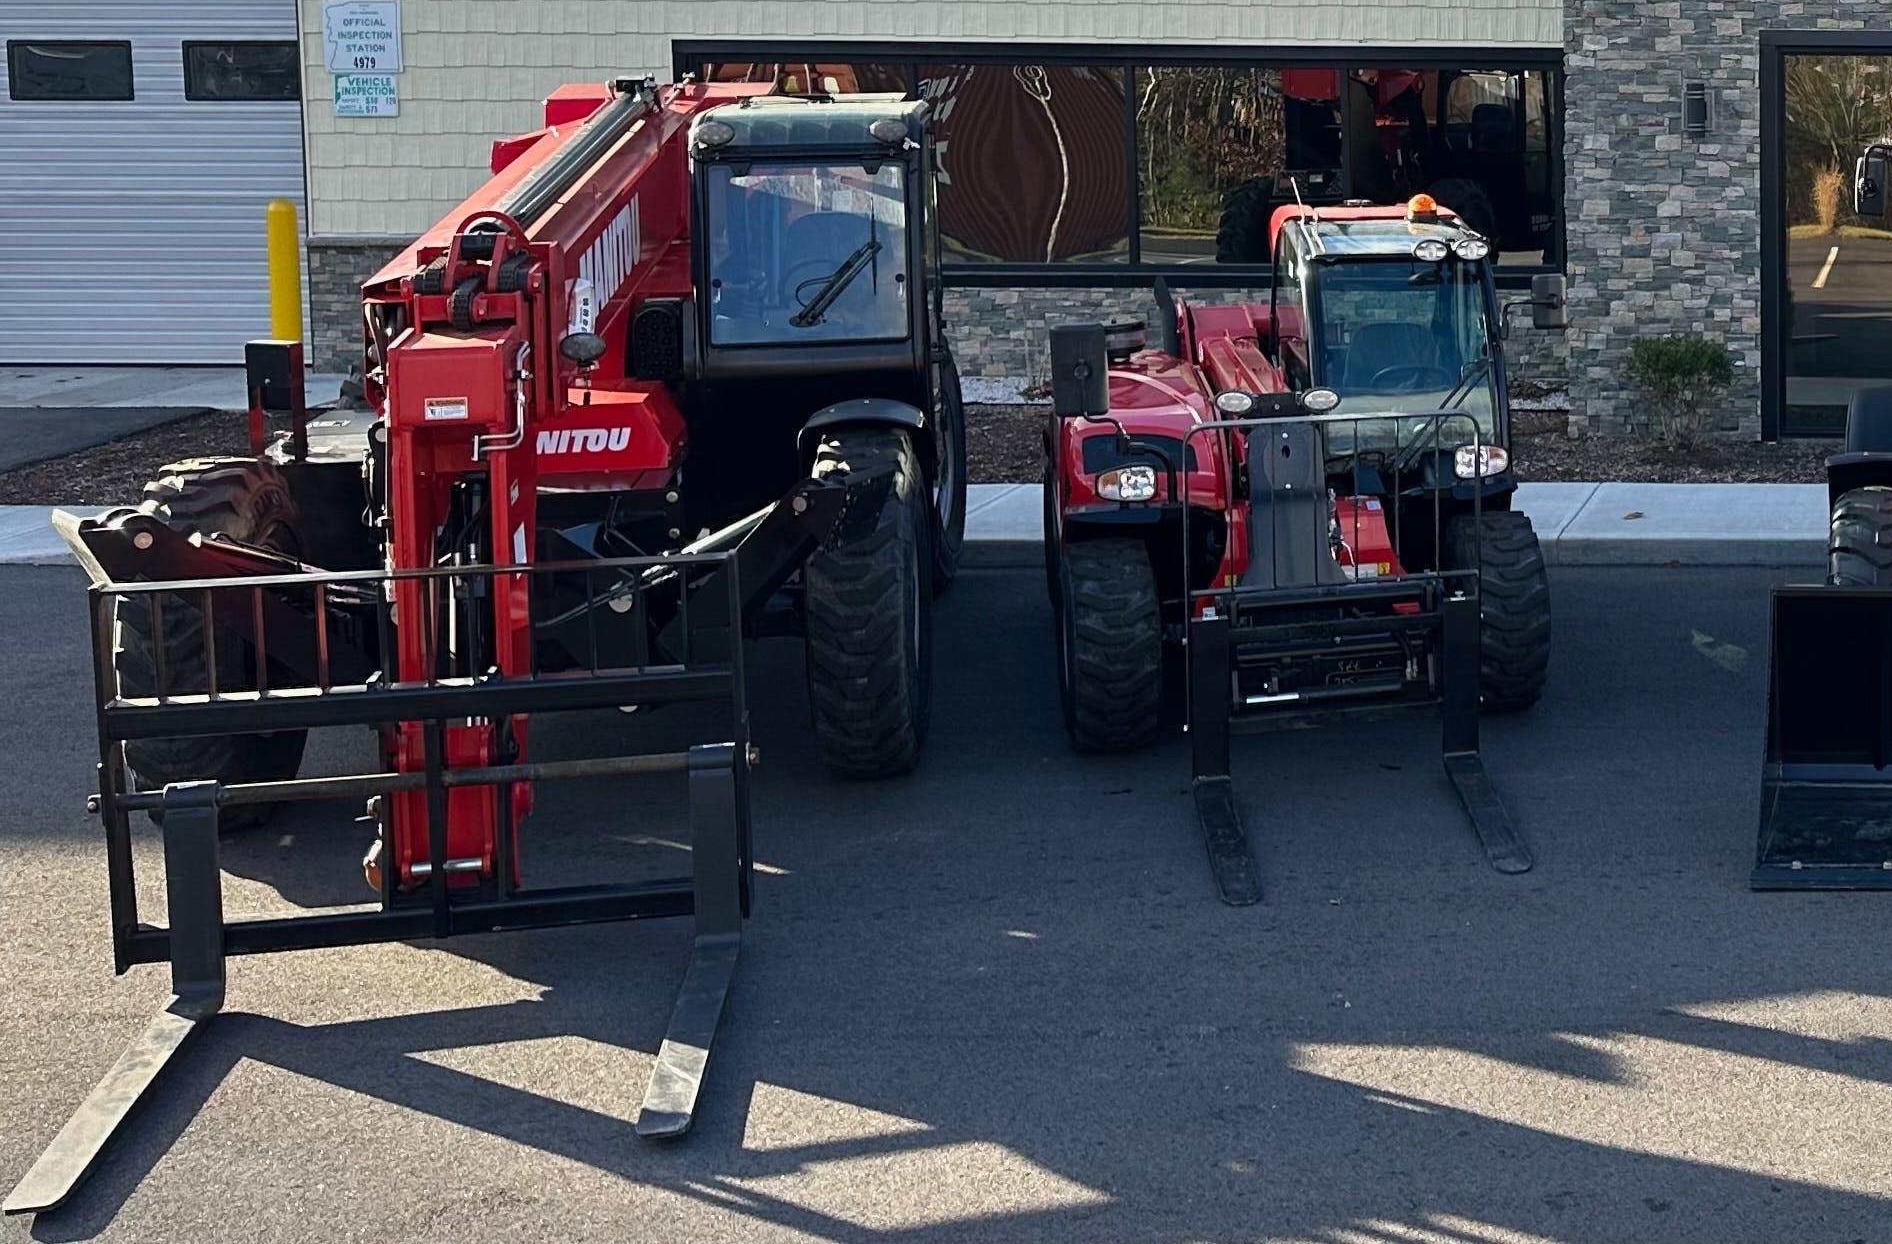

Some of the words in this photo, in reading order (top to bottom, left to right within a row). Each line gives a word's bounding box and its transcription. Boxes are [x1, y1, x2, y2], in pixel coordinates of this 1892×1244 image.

[342, 18, 386, 27] OFFICIAL
[337, 31, 393, 39] INSPECTION
[345, 44, 386, 53] STATION
[353, 56, 376, 69] 4979
[347, 77, 392, 86] VEHICLE
[341, 87, 396, 96] INSPECTION
[536, 427, 632, 455] NITOU
